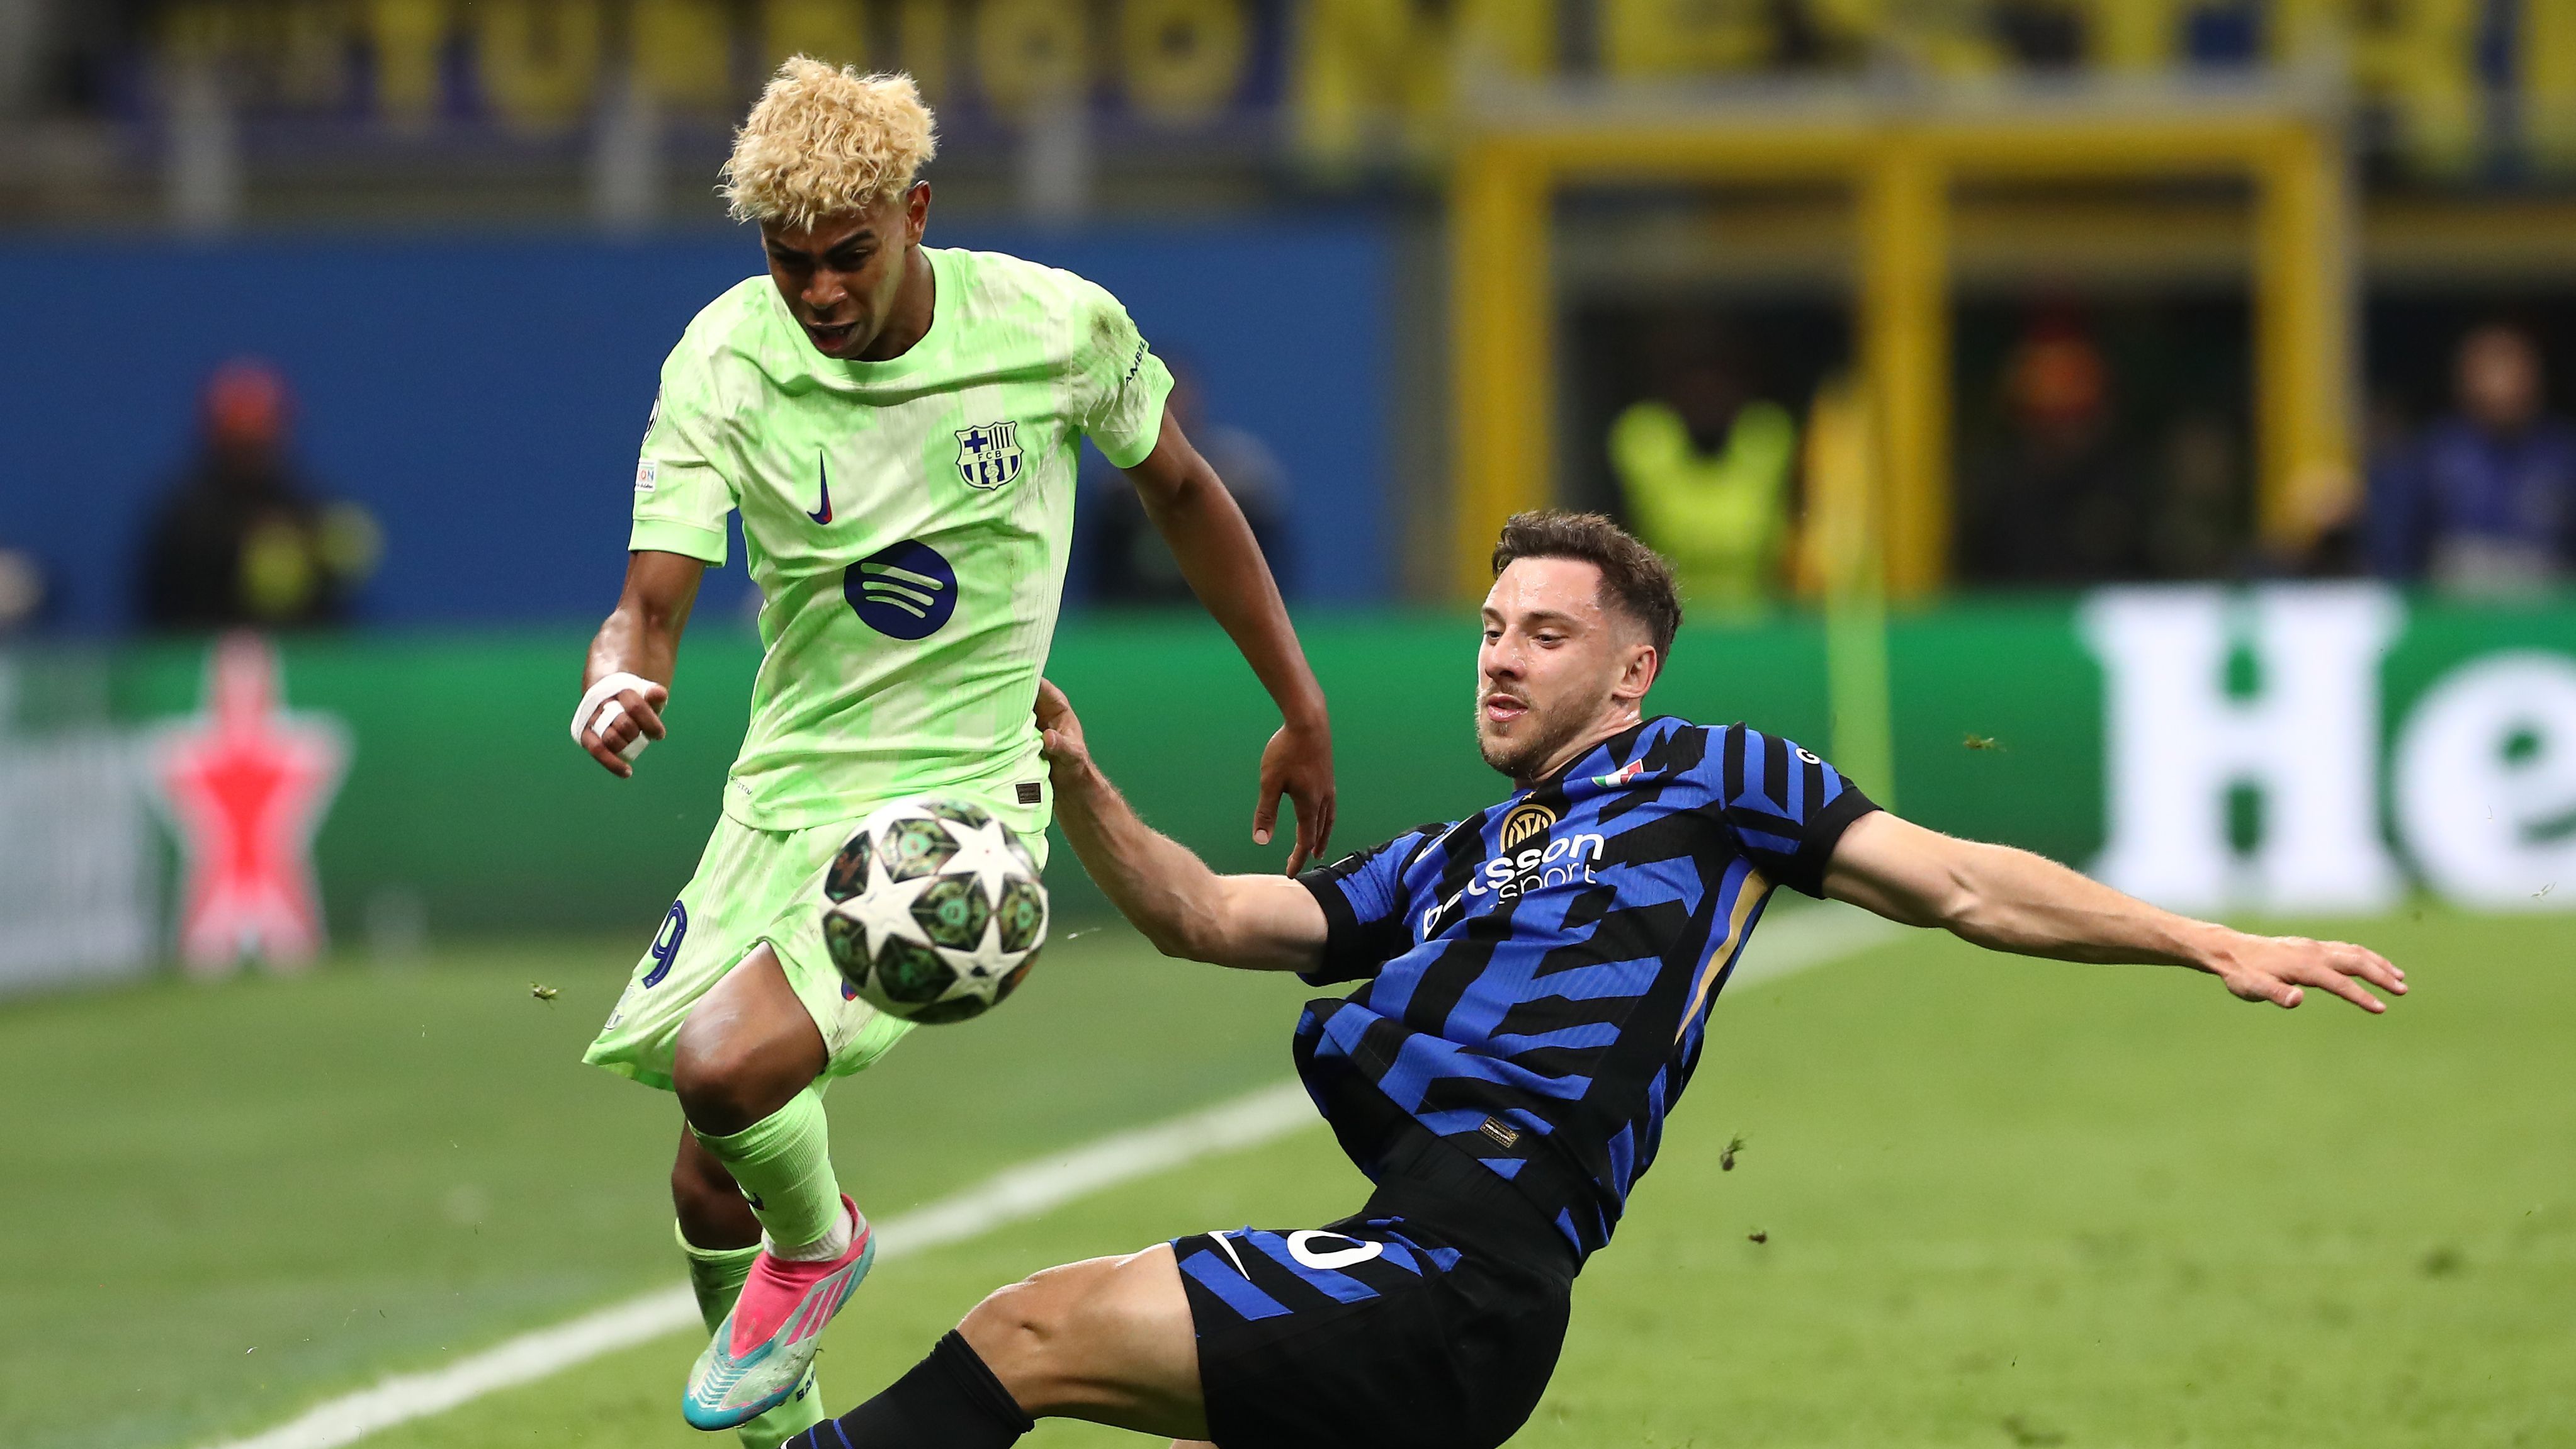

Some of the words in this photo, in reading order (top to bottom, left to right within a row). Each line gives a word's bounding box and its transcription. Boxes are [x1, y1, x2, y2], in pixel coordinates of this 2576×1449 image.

[978, 450, 1002, 461] FCB
[2075, 580, 2576, 910] He
[1423, 833, 1605, 940] btsson
